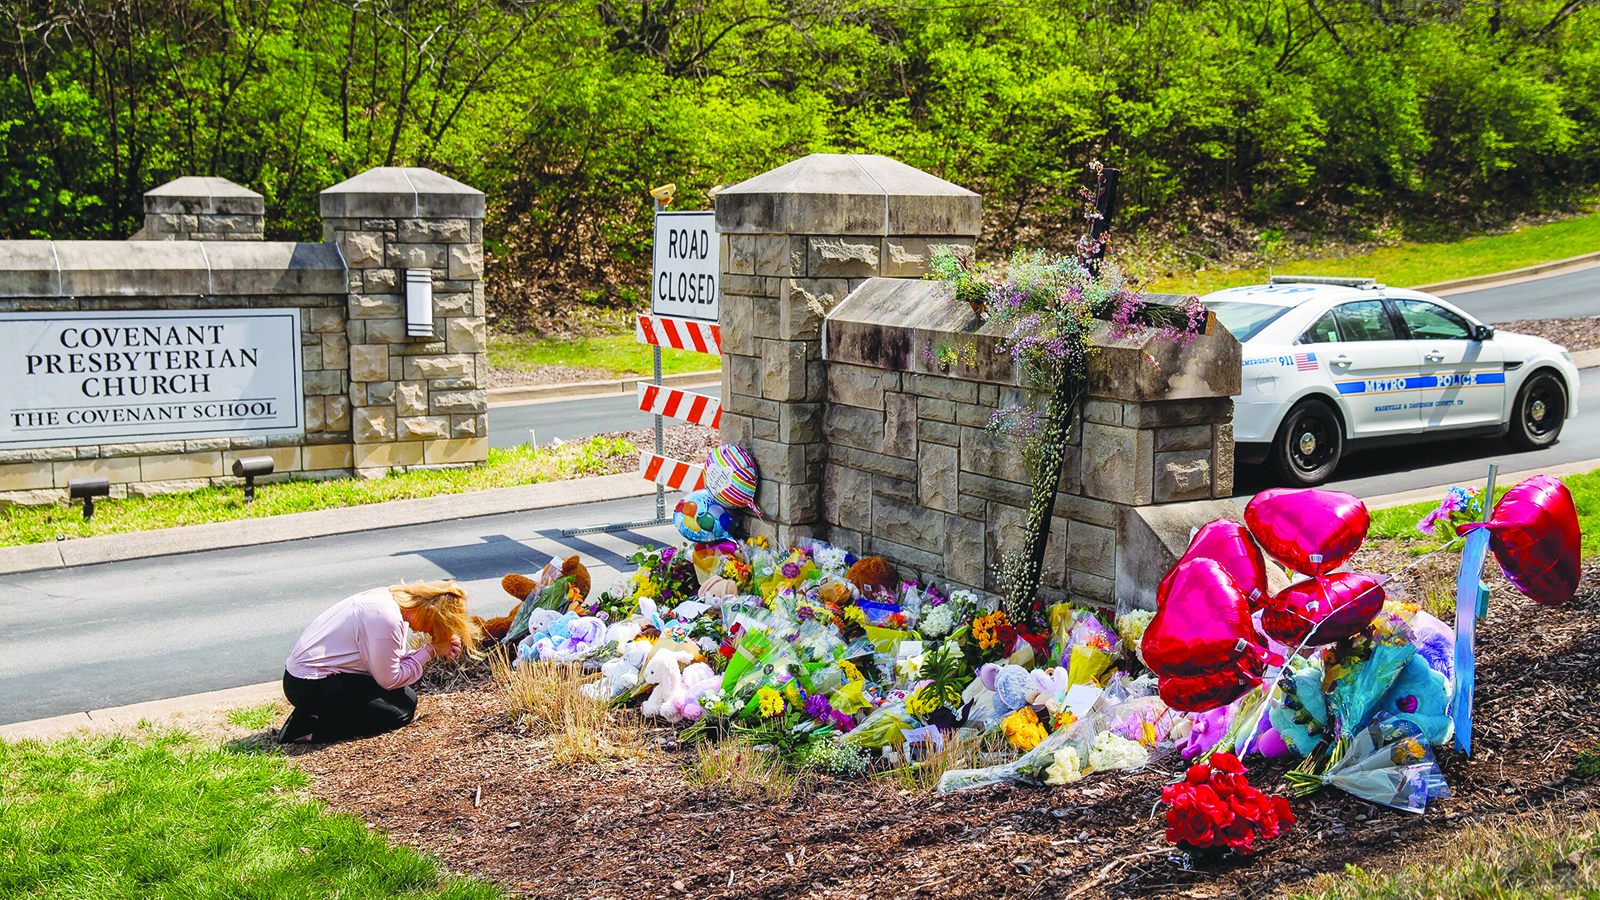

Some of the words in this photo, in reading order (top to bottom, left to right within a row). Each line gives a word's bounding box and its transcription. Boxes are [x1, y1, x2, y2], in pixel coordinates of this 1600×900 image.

[669, 229, 708, 259] ROAD
[658, 271, 715, 305] CLOSED
[60, 325, 225, 349] COVENANT
[25, 348, 259, 375] PRESBYTERIAN
[1278, 355, 1294, 366] 911
[81, 374, 211, 398] CHURCH
[1365, 378, 1406, 392] METRO
[1437, 374, 1477, 387] POLICE
[11, 411, 60, 427] THE
[67, 406, 187, 424] COVENANT
[193, 402, 277, 420] SCHOOL
[1374, 404, 1402, 412] NASHVILLE
[1408, 402, 1433, 410] DAVIDSON
